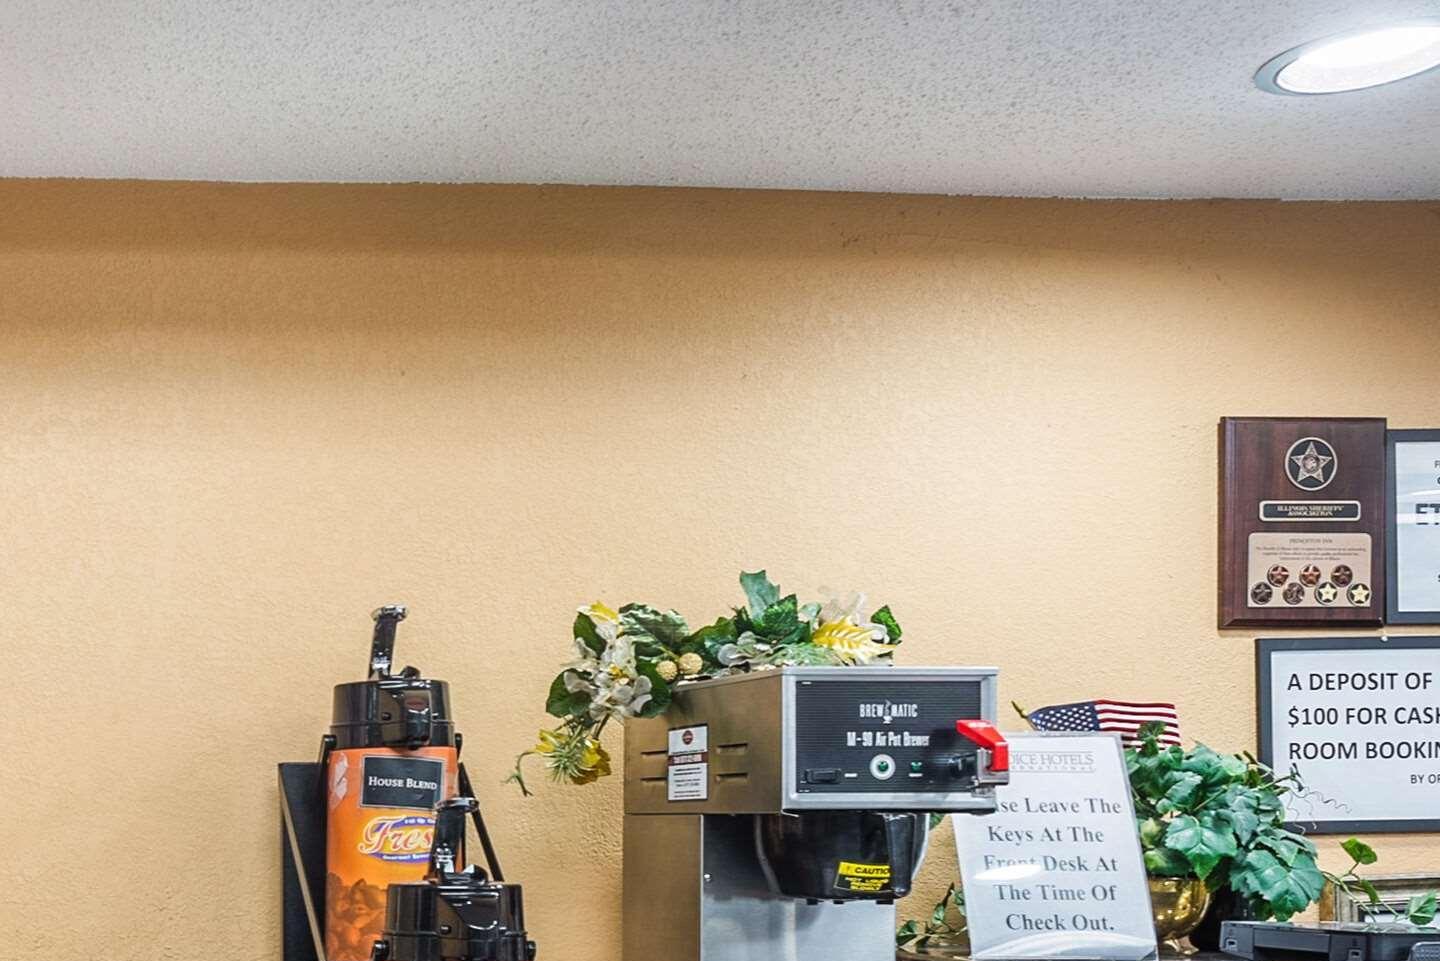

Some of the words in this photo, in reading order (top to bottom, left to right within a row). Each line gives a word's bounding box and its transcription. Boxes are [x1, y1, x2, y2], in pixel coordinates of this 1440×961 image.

[1288, 673, 1302, 691] A
[1309, 672, 1399, 691] DEPOSIT
[1405, 672, 1433, 690] OF
[1288, 706, 1339, 728] $100
[1346, 707, 1387, 725] FOR
[1289, 742, 1358, 760] ROOM
[368, 776, 404, 787] HOUSE
[406, 778, 438, 790] BLEND
[1410, 774, 1424, 784] BY
[1024, 797, 1080, 814] Leave
[1083, 797, 1122, 814] The
[357, 815, 435, 854] Fres
[987, 825, 1034, 846] Keys
[1040, 826, 1062, 842] At
[1067, 826, 1104, 842] The
[854, 866, 889, 875] CAUTIO
[1041, 854, 1090, 872] Desk
[1095, 856, 1119, 872] At
[992, 884, 1031, 901] The
[1035, 884, 1086, 901] Time
[1091, 884, 1117, 901] Of
[1005, 913, 1066, 931] Check
[1071, 913, 1115, 931] Out.
